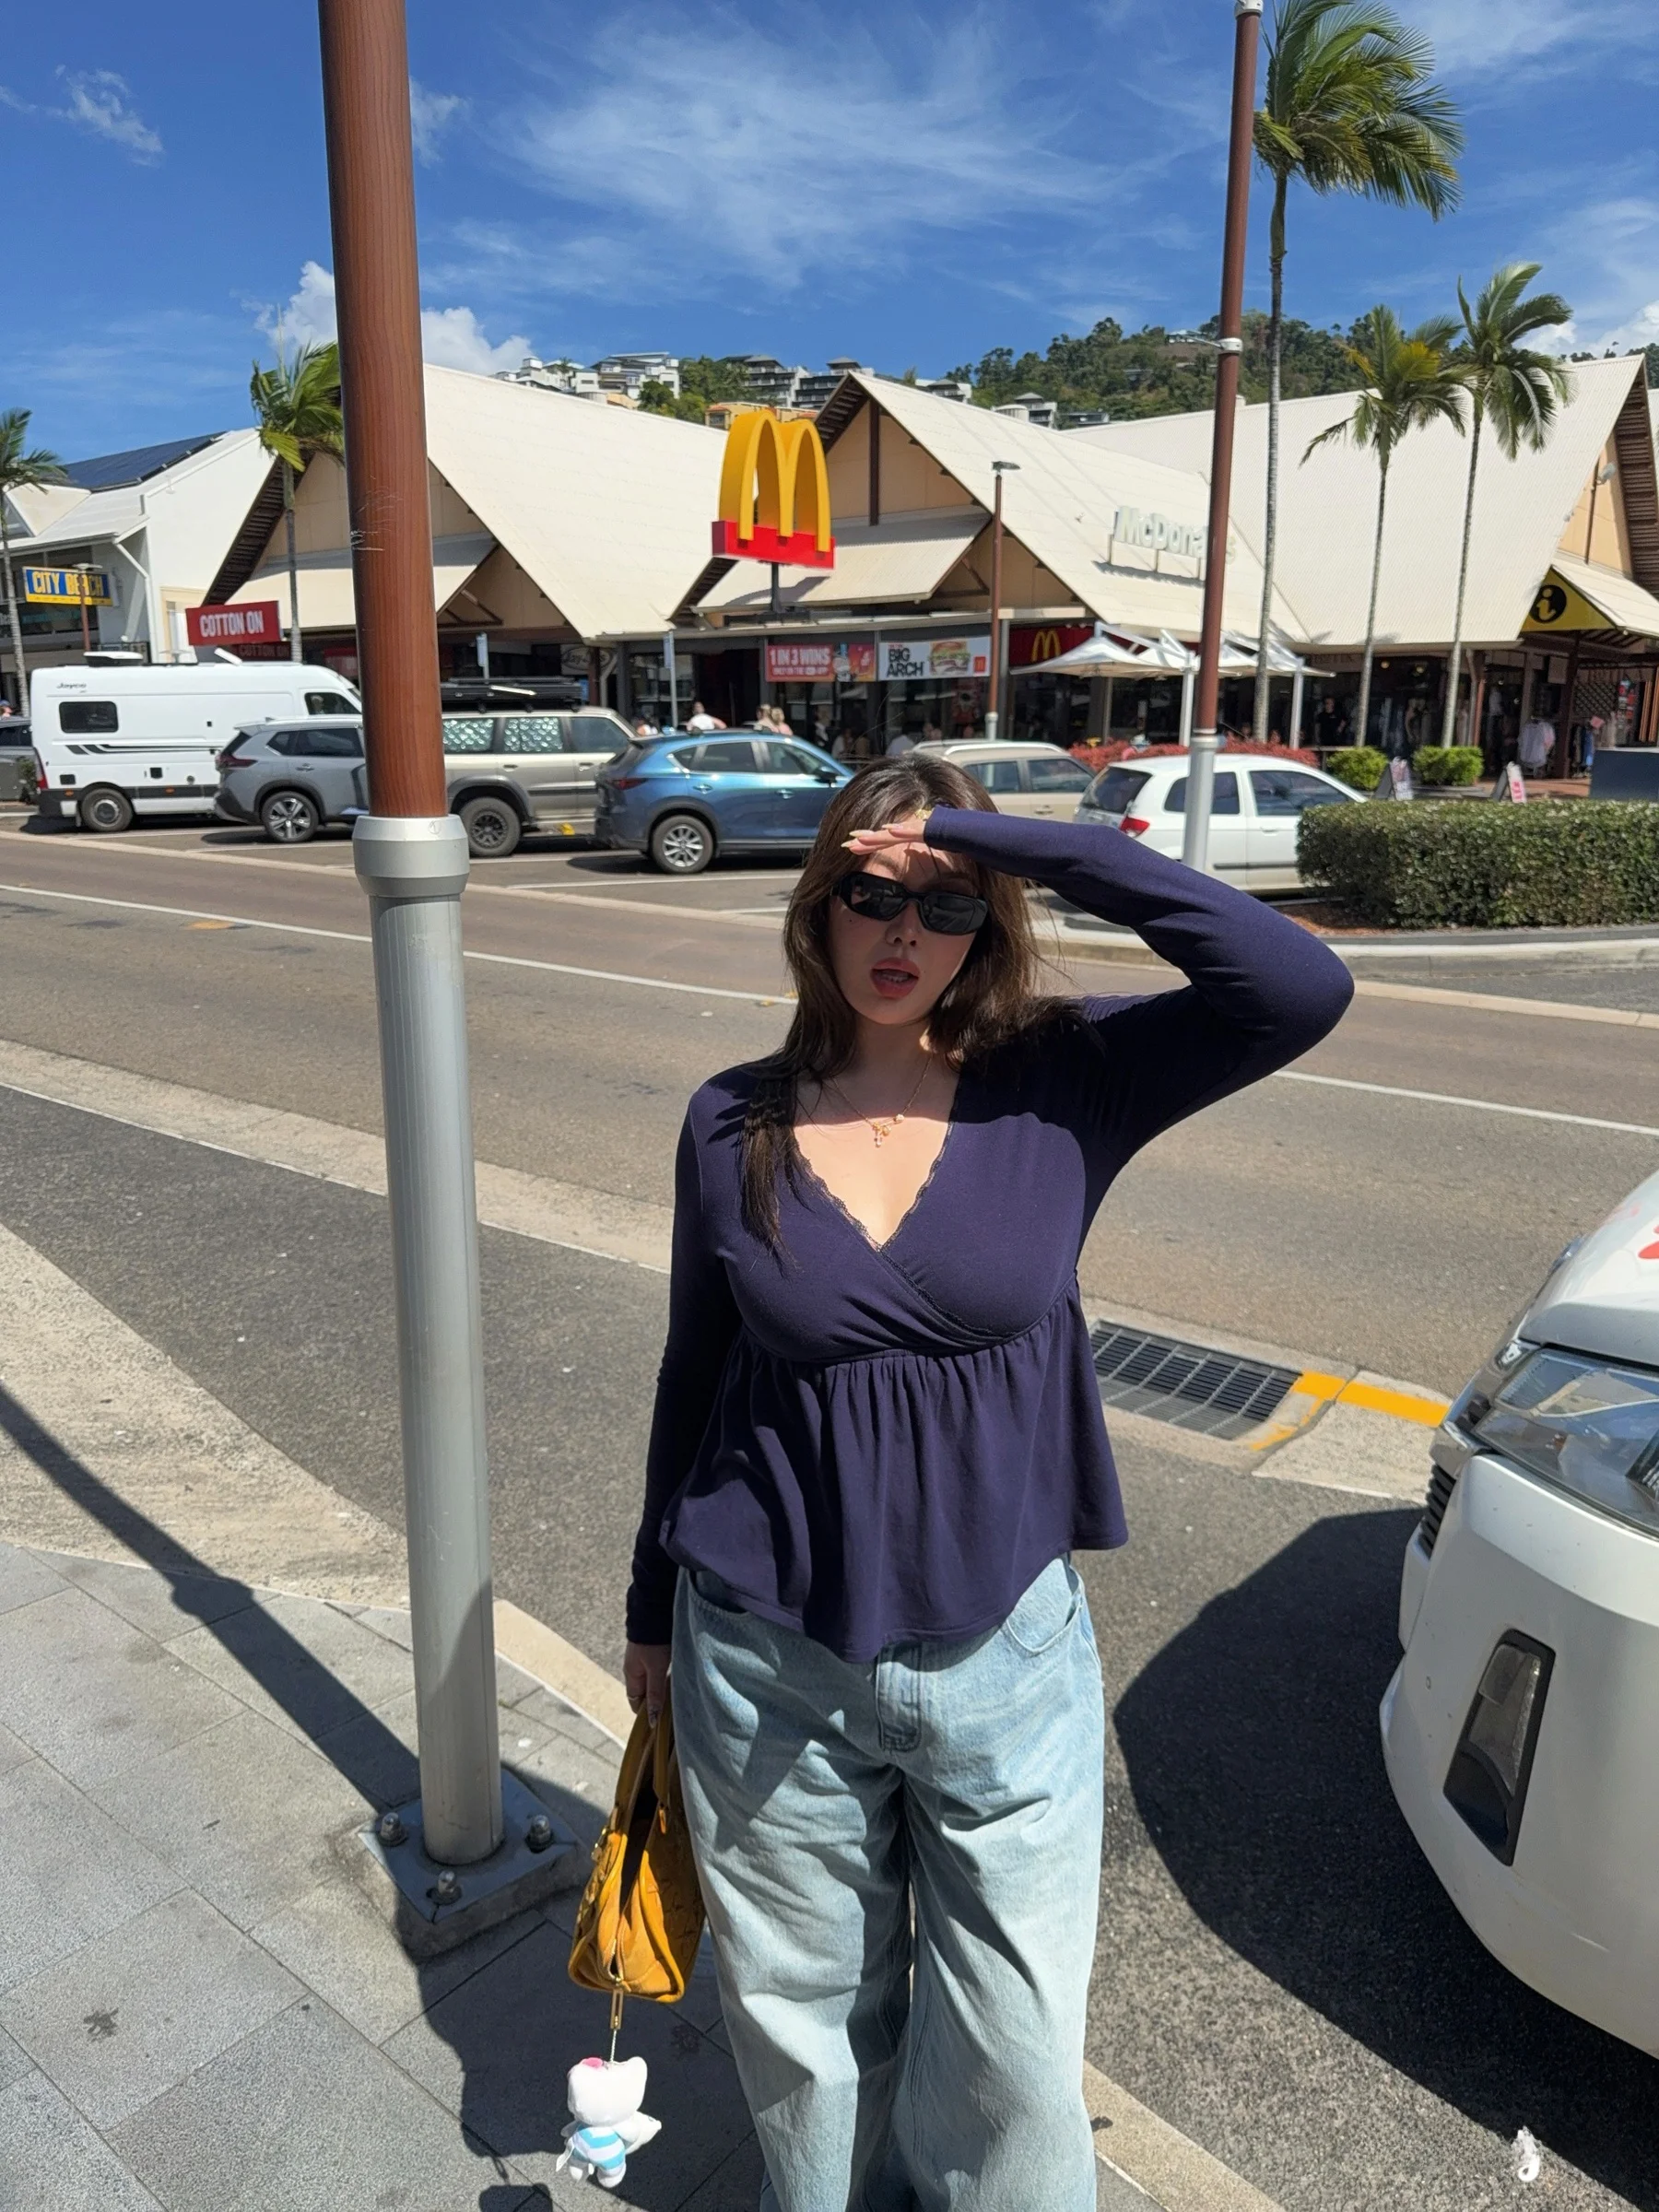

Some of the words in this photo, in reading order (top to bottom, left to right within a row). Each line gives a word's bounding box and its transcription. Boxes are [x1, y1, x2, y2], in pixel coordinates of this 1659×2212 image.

[32, 571, 60, 595] CITY
[199, 612, 245, 638] COTTON
[246, 610, 265, 635] ON
[770, 648, 776, 665] 1
[777, 648, 790, 665] IN
[791, 648, 798, 665] 3
[888, 648, 911, 662] BIG
[886, 662, 924, 677] ARCH
